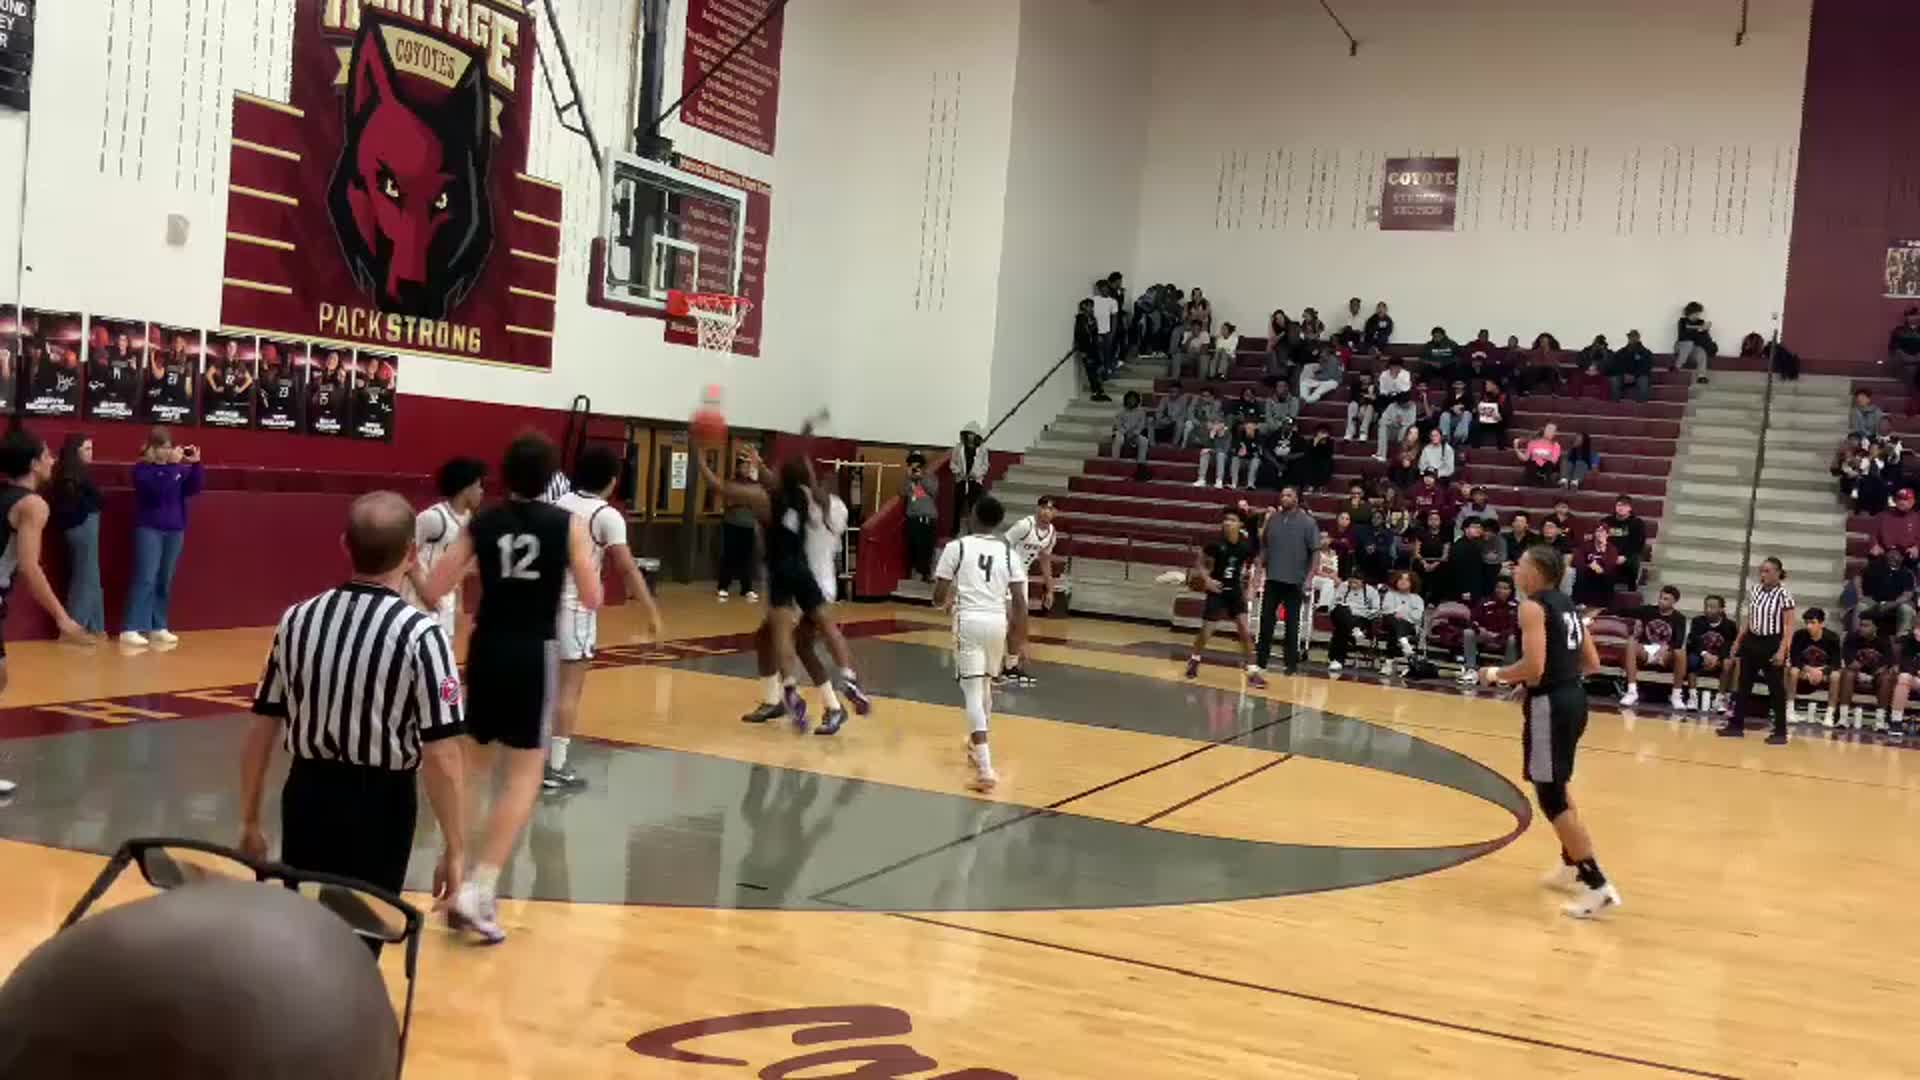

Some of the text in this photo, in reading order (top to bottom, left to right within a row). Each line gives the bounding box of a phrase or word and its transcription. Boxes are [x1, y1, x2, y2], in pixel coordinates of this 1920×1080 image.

[395, 39, 456, 80] COYOTES
[1388, 172, 1456, 186] COYOTE
[497, 533, 541, 579] 12
[978, 554, 993, 582] 4
